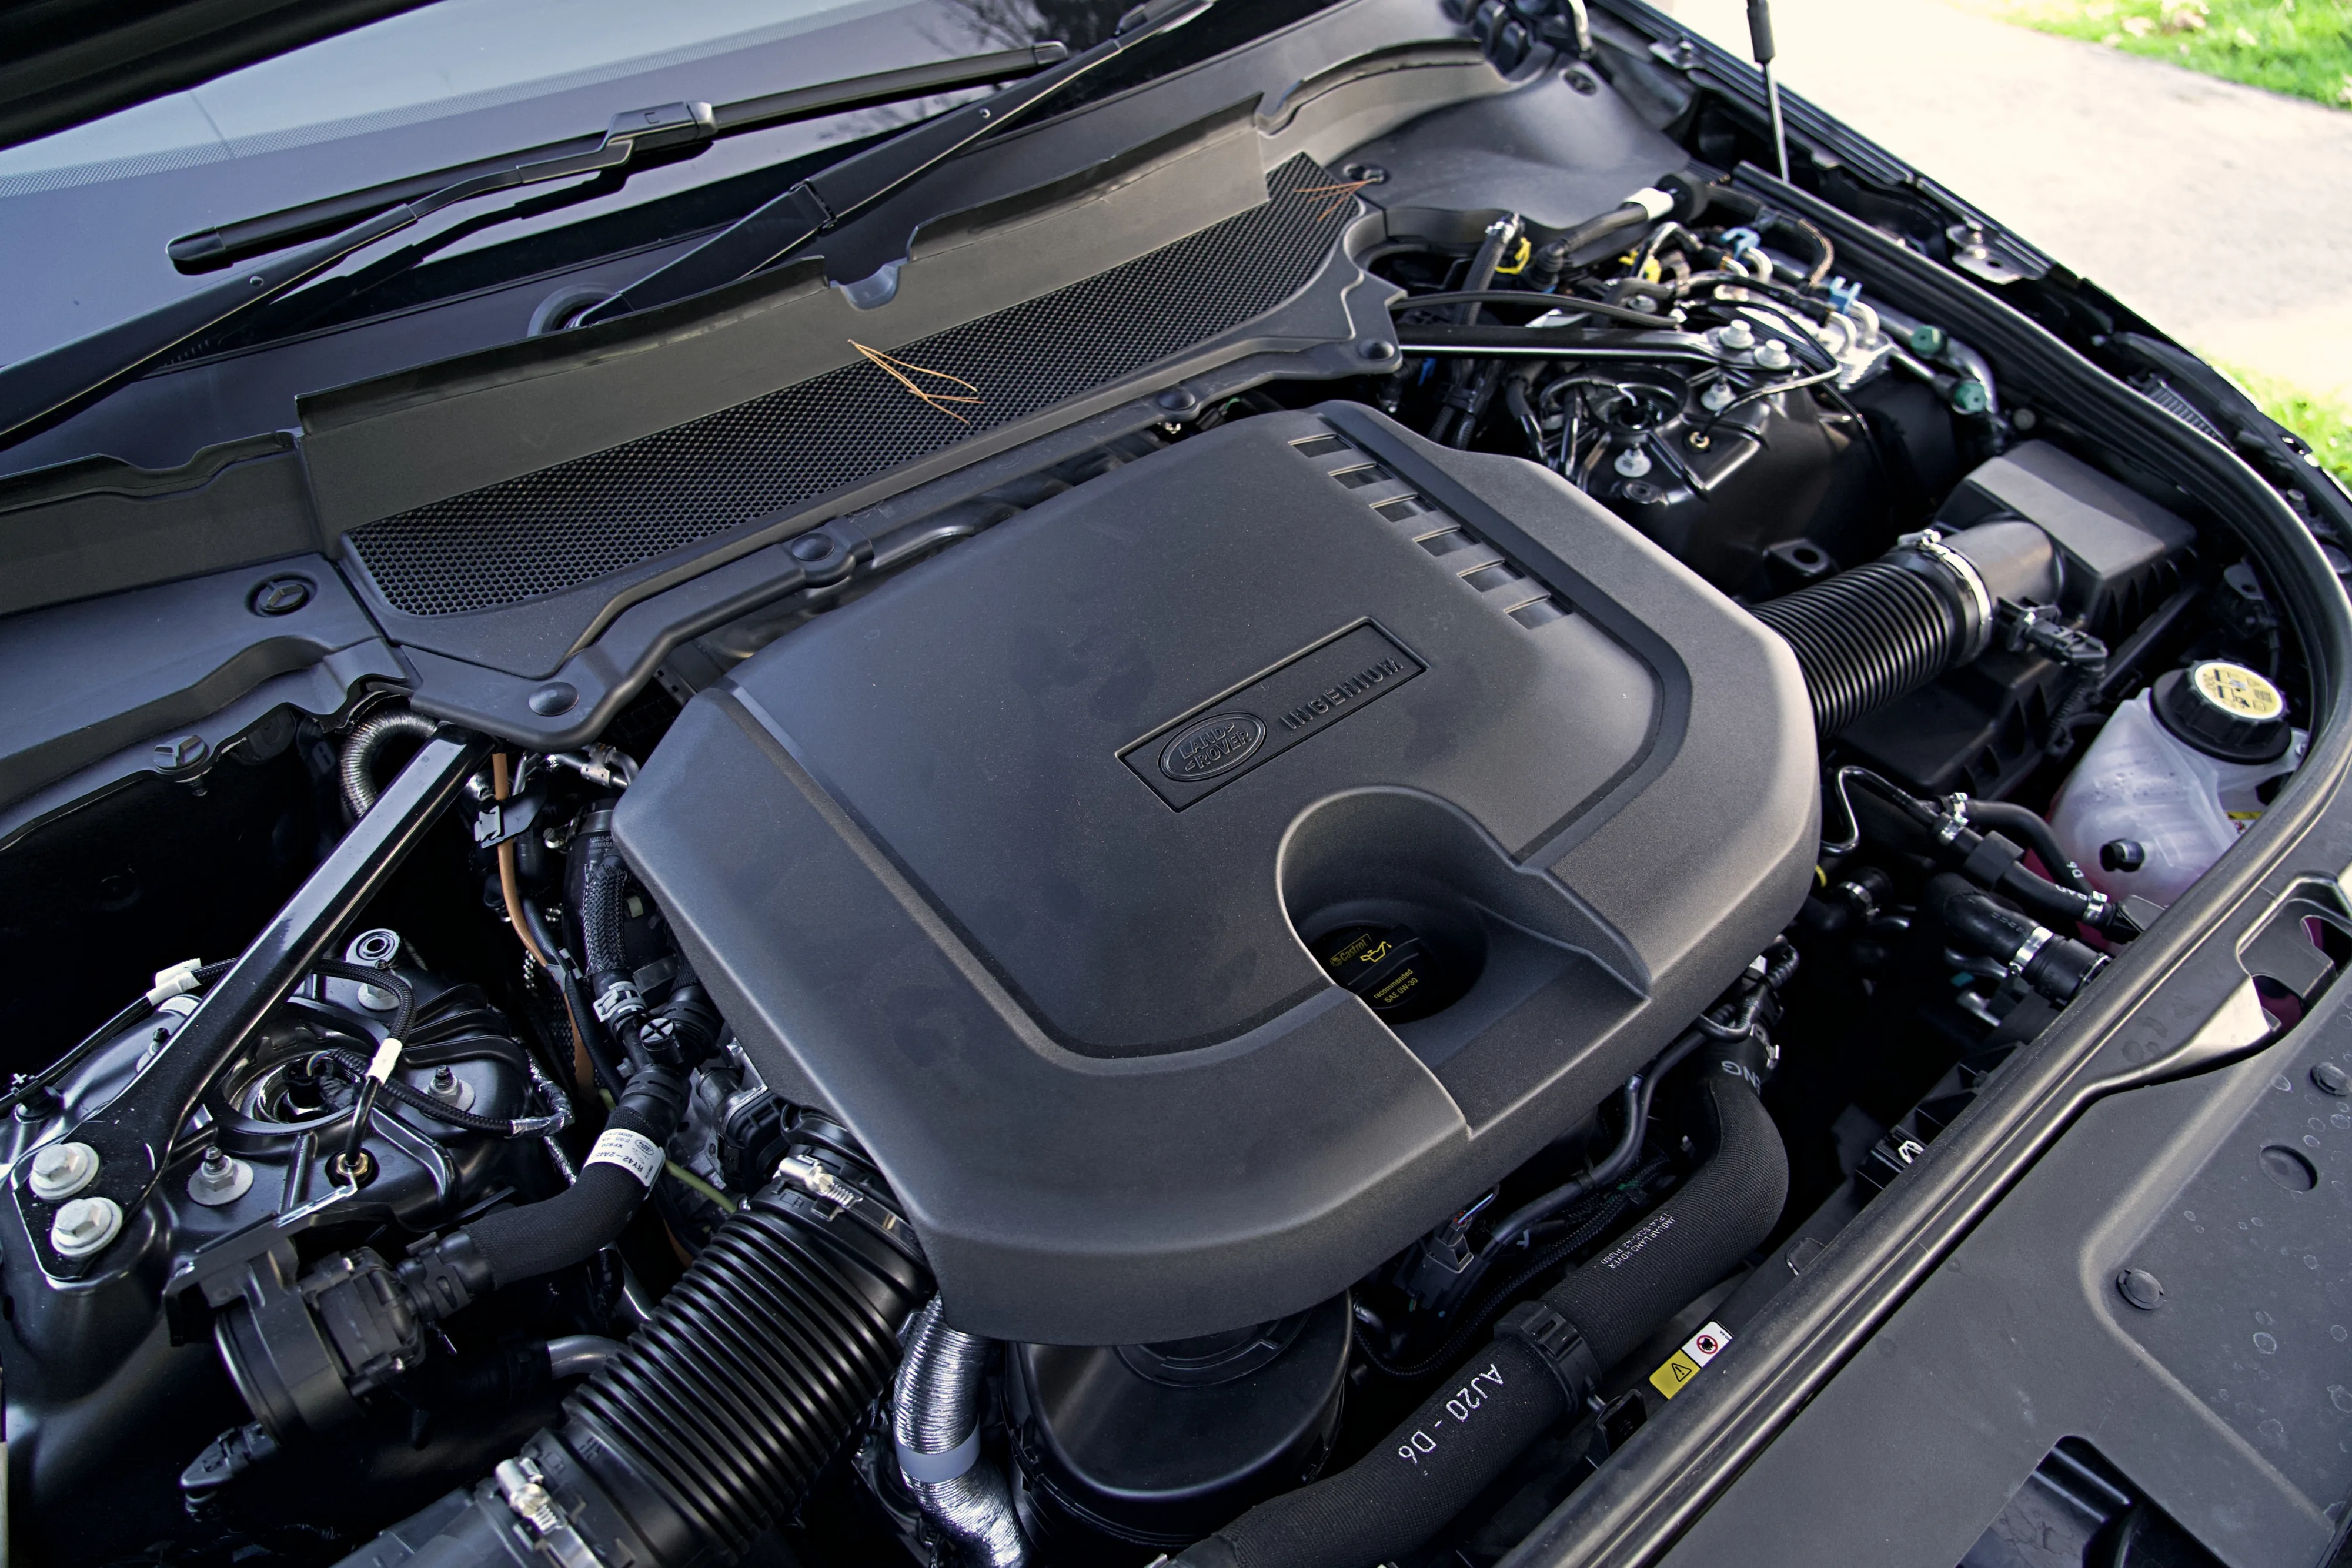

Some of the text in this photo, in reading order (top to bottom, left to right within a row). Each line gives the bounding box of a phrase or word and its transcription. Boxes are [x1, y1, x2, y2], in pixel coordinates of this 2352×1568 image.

[1280, 657, 1404, 730] INGENIUM
[1179, 727, 1227, 759] LAND
[1197, 730, 1252, 769] ROVER
[1339, 940, 1369, 962] Castrol
[1374, 969, 1413, 999] recommended
[1384, 977, 1418, 1004] SAE 0W-30
[1630, 1236, 1652, 1252] LAND
[1446, 1363, 1504, 1422] AJ20
[1398, 1431, 1437, 1465] D6
